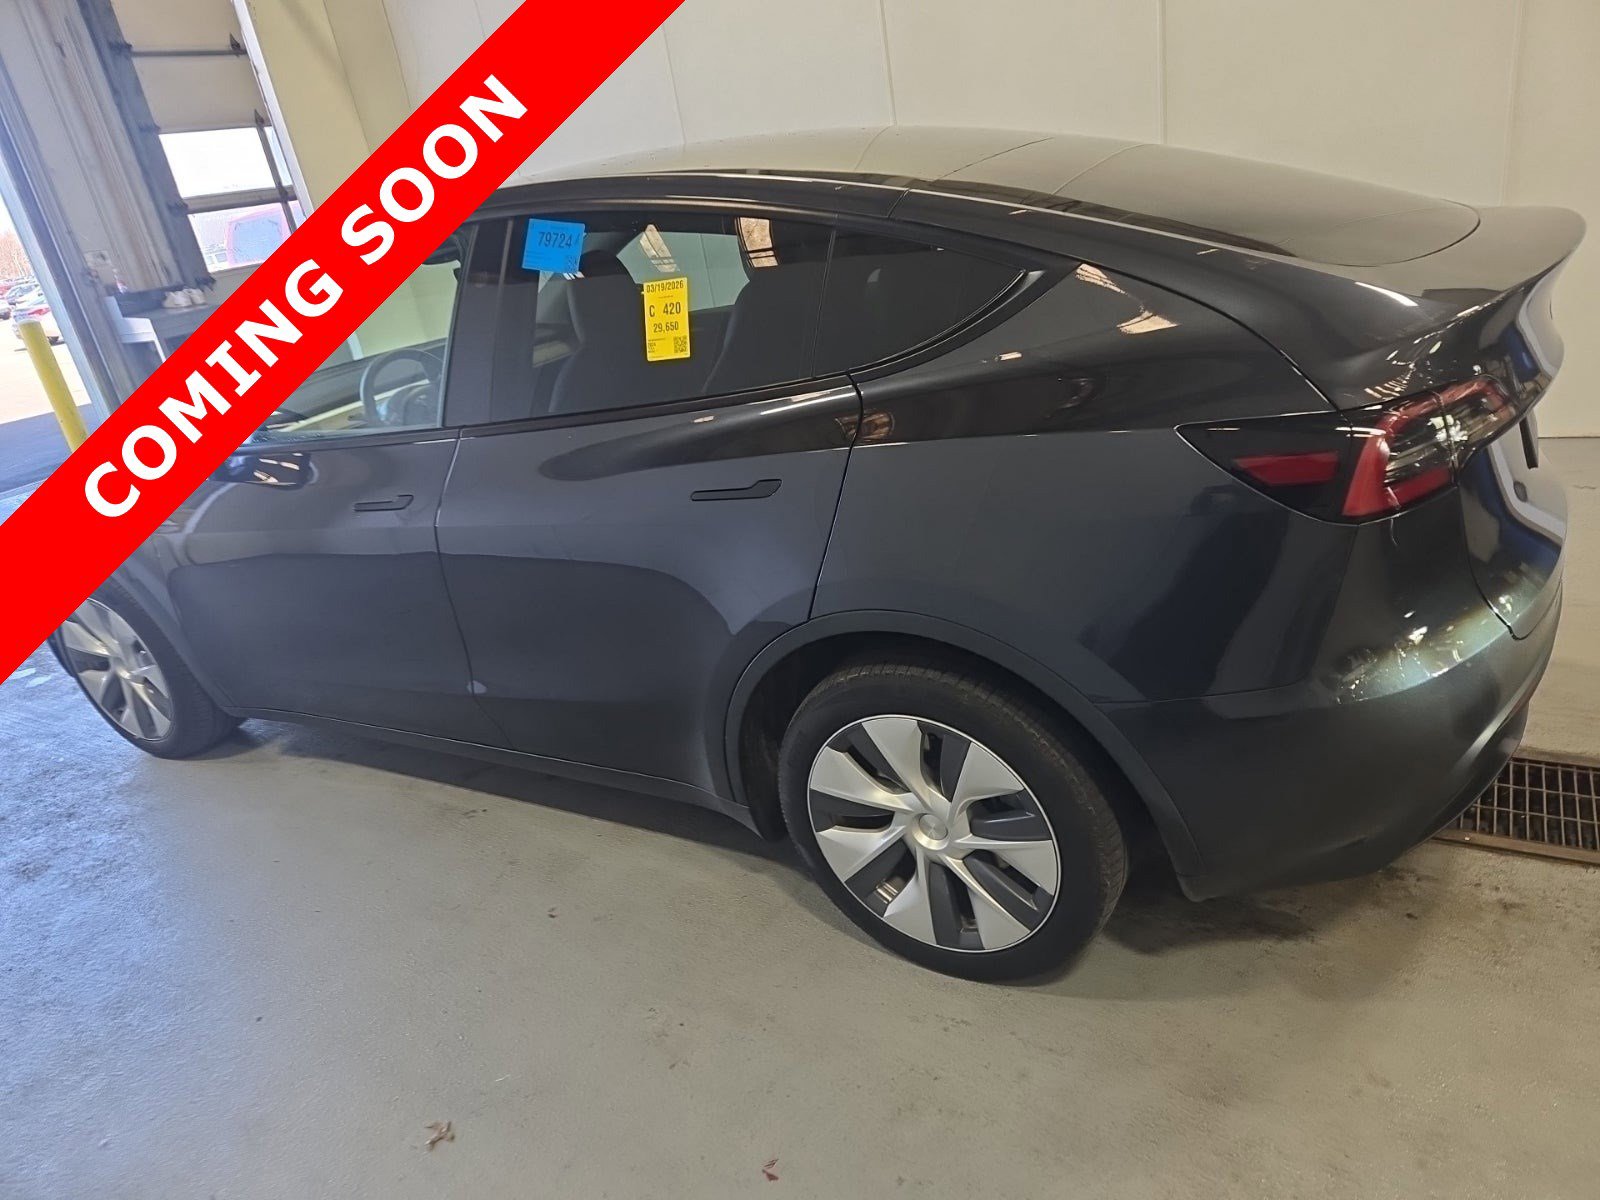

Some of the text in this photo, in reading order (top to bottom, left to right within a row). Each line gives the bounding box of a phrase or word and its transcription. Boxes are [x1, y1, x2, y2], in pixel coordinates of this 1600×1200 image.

[538, 231, 572, 248] 79724
[646, 280, 684, 293] 03/19/2026
[649, 302, 681, 318] C 420
[653, 321, 679, 333] 29,650
